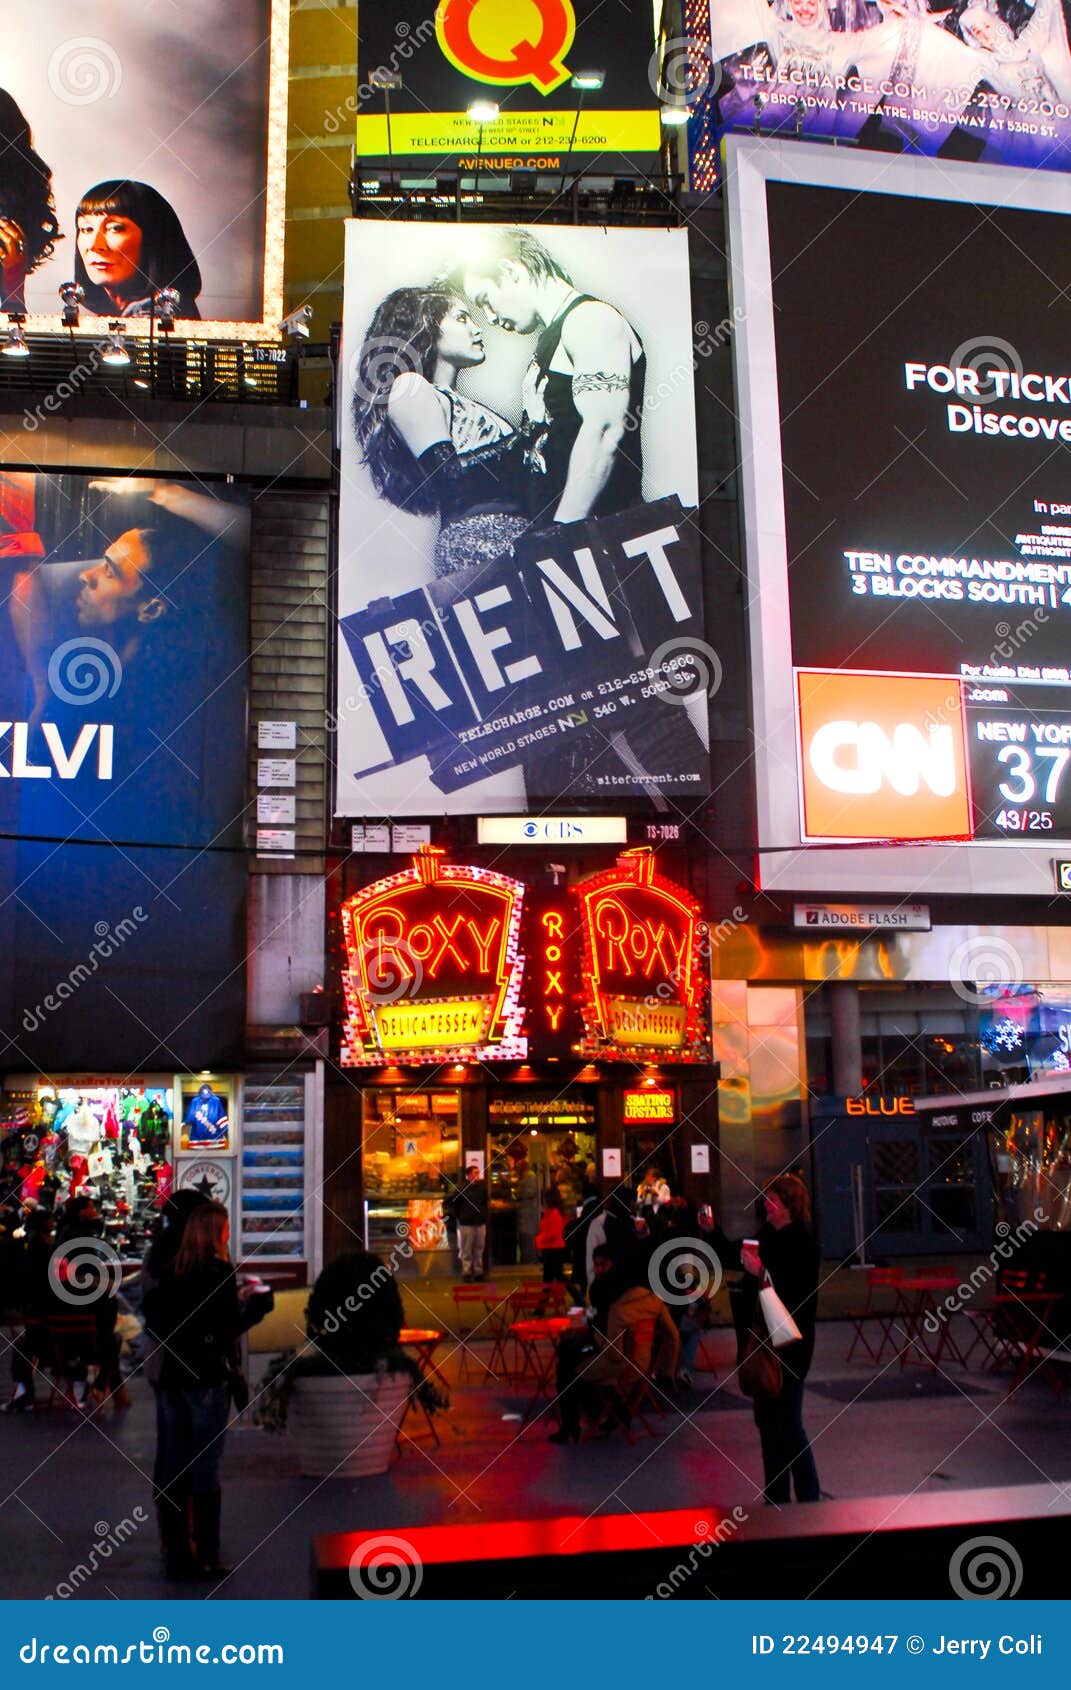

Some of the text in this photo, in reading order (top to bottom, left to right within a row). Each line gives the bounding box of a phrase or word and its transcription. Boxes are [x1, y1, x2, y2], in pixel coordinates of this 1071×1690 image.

[435, 0, 576, 97] Q
[739, 63, 1070, 119] TELECHARGE.COM 212-239-6200
[771, 93, 1058, 138] BROADWAY THEATRE, BROADWAY AT 53RD ST.
[410, 135, 607, 147] TELECHARGE.COM or 212-239-6200
[256, 348, 287, 362] TS-7022
[904, 362, 1071, 404] FOR TICK
[947, 403, 1071, 442] Discove
[1033, 499, 1048, 513] In
[844, 551, 892, 574] TEN
[852, 574, 867, 594] 3
[872, 575, 963, 600] BLOCKS
[968, 581, 1046, 605] SOUTH
[362, 525, 693, 726] RENT
[458, 694, 575, 744] TELECHARGE.COM
[597, 654, 695, 695] 212-239-6200
[968, 688, 1008, 702] .com
[453, 759, 479, 776] NEW
[478, 742, 516, 765] WORLD
[517, 724, 557, 748] STAGES
[593, 701, 617, 719] 340
[619, 695, 636, 707] W.
[641, 680, 672, 699] 50th
[977, 721, 1026, 742] NEW
[809, 719, 957, 797] CNN
[597, 771, 701, 785] siteforrent.com
[997, 745, 1071, 803] 37
[545, 822, 583, 838] CBS
[995, 810, 1053, 830] 43/25
[822, 913, 907, 924] ADOBE FLASH
[381, 1013, 479, 1036] DELICATESSEN
[626, 1094, 671, 1106] SEATING
[846, 1096, 916, 1116] BLUE
[625, 1106, 673, 1118] UPSTAIRS
